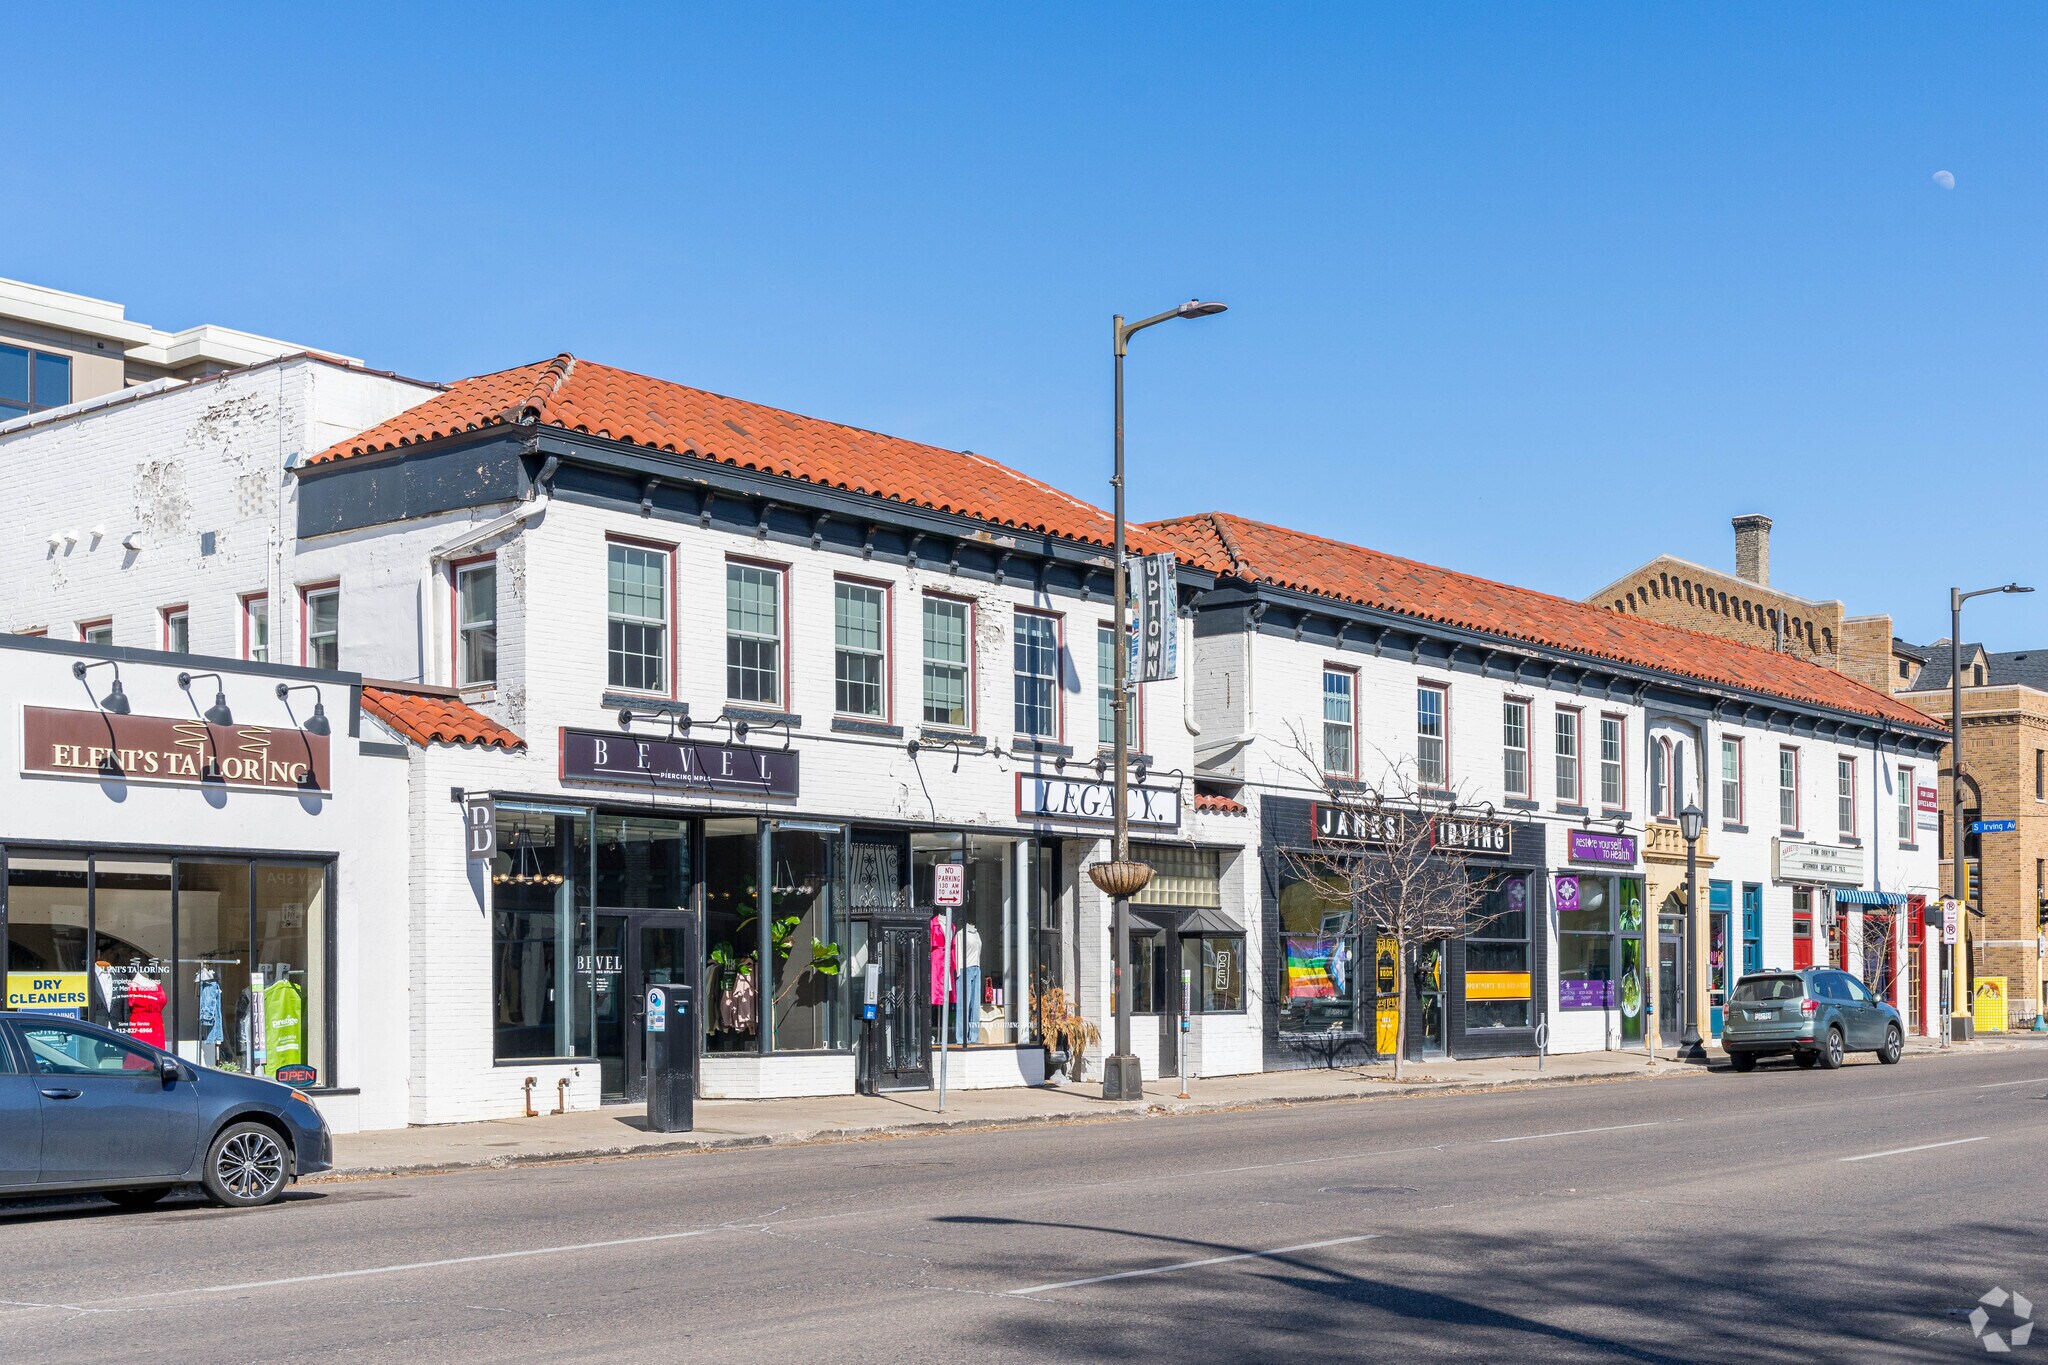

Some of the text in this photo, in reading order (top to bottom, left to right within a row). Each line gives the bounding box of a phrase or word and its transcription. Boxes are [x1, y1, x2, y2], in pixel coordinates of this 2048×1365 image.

[1146, 560, 1159, 678] UPTOWN
[52, 742, 308, 785] ELENI'S TAILORING
[593, 738, 773, 781] BEVEL
[660, 772, 692, 782] PIERCING
[1321, 811, 1396, 840] JAMES
[1439, 822, 1504, 849] IRVING
[1984, 823, 2002, 831] Irving
[1217, 954, 1228, 986] OPEN
[34, 980, 62, 990] DRY
[10, 992, 86, 1004] CLEANERS
[272, 1015, 298, 1028] prestige
[278, 1071, 315, 1081] OPEN
